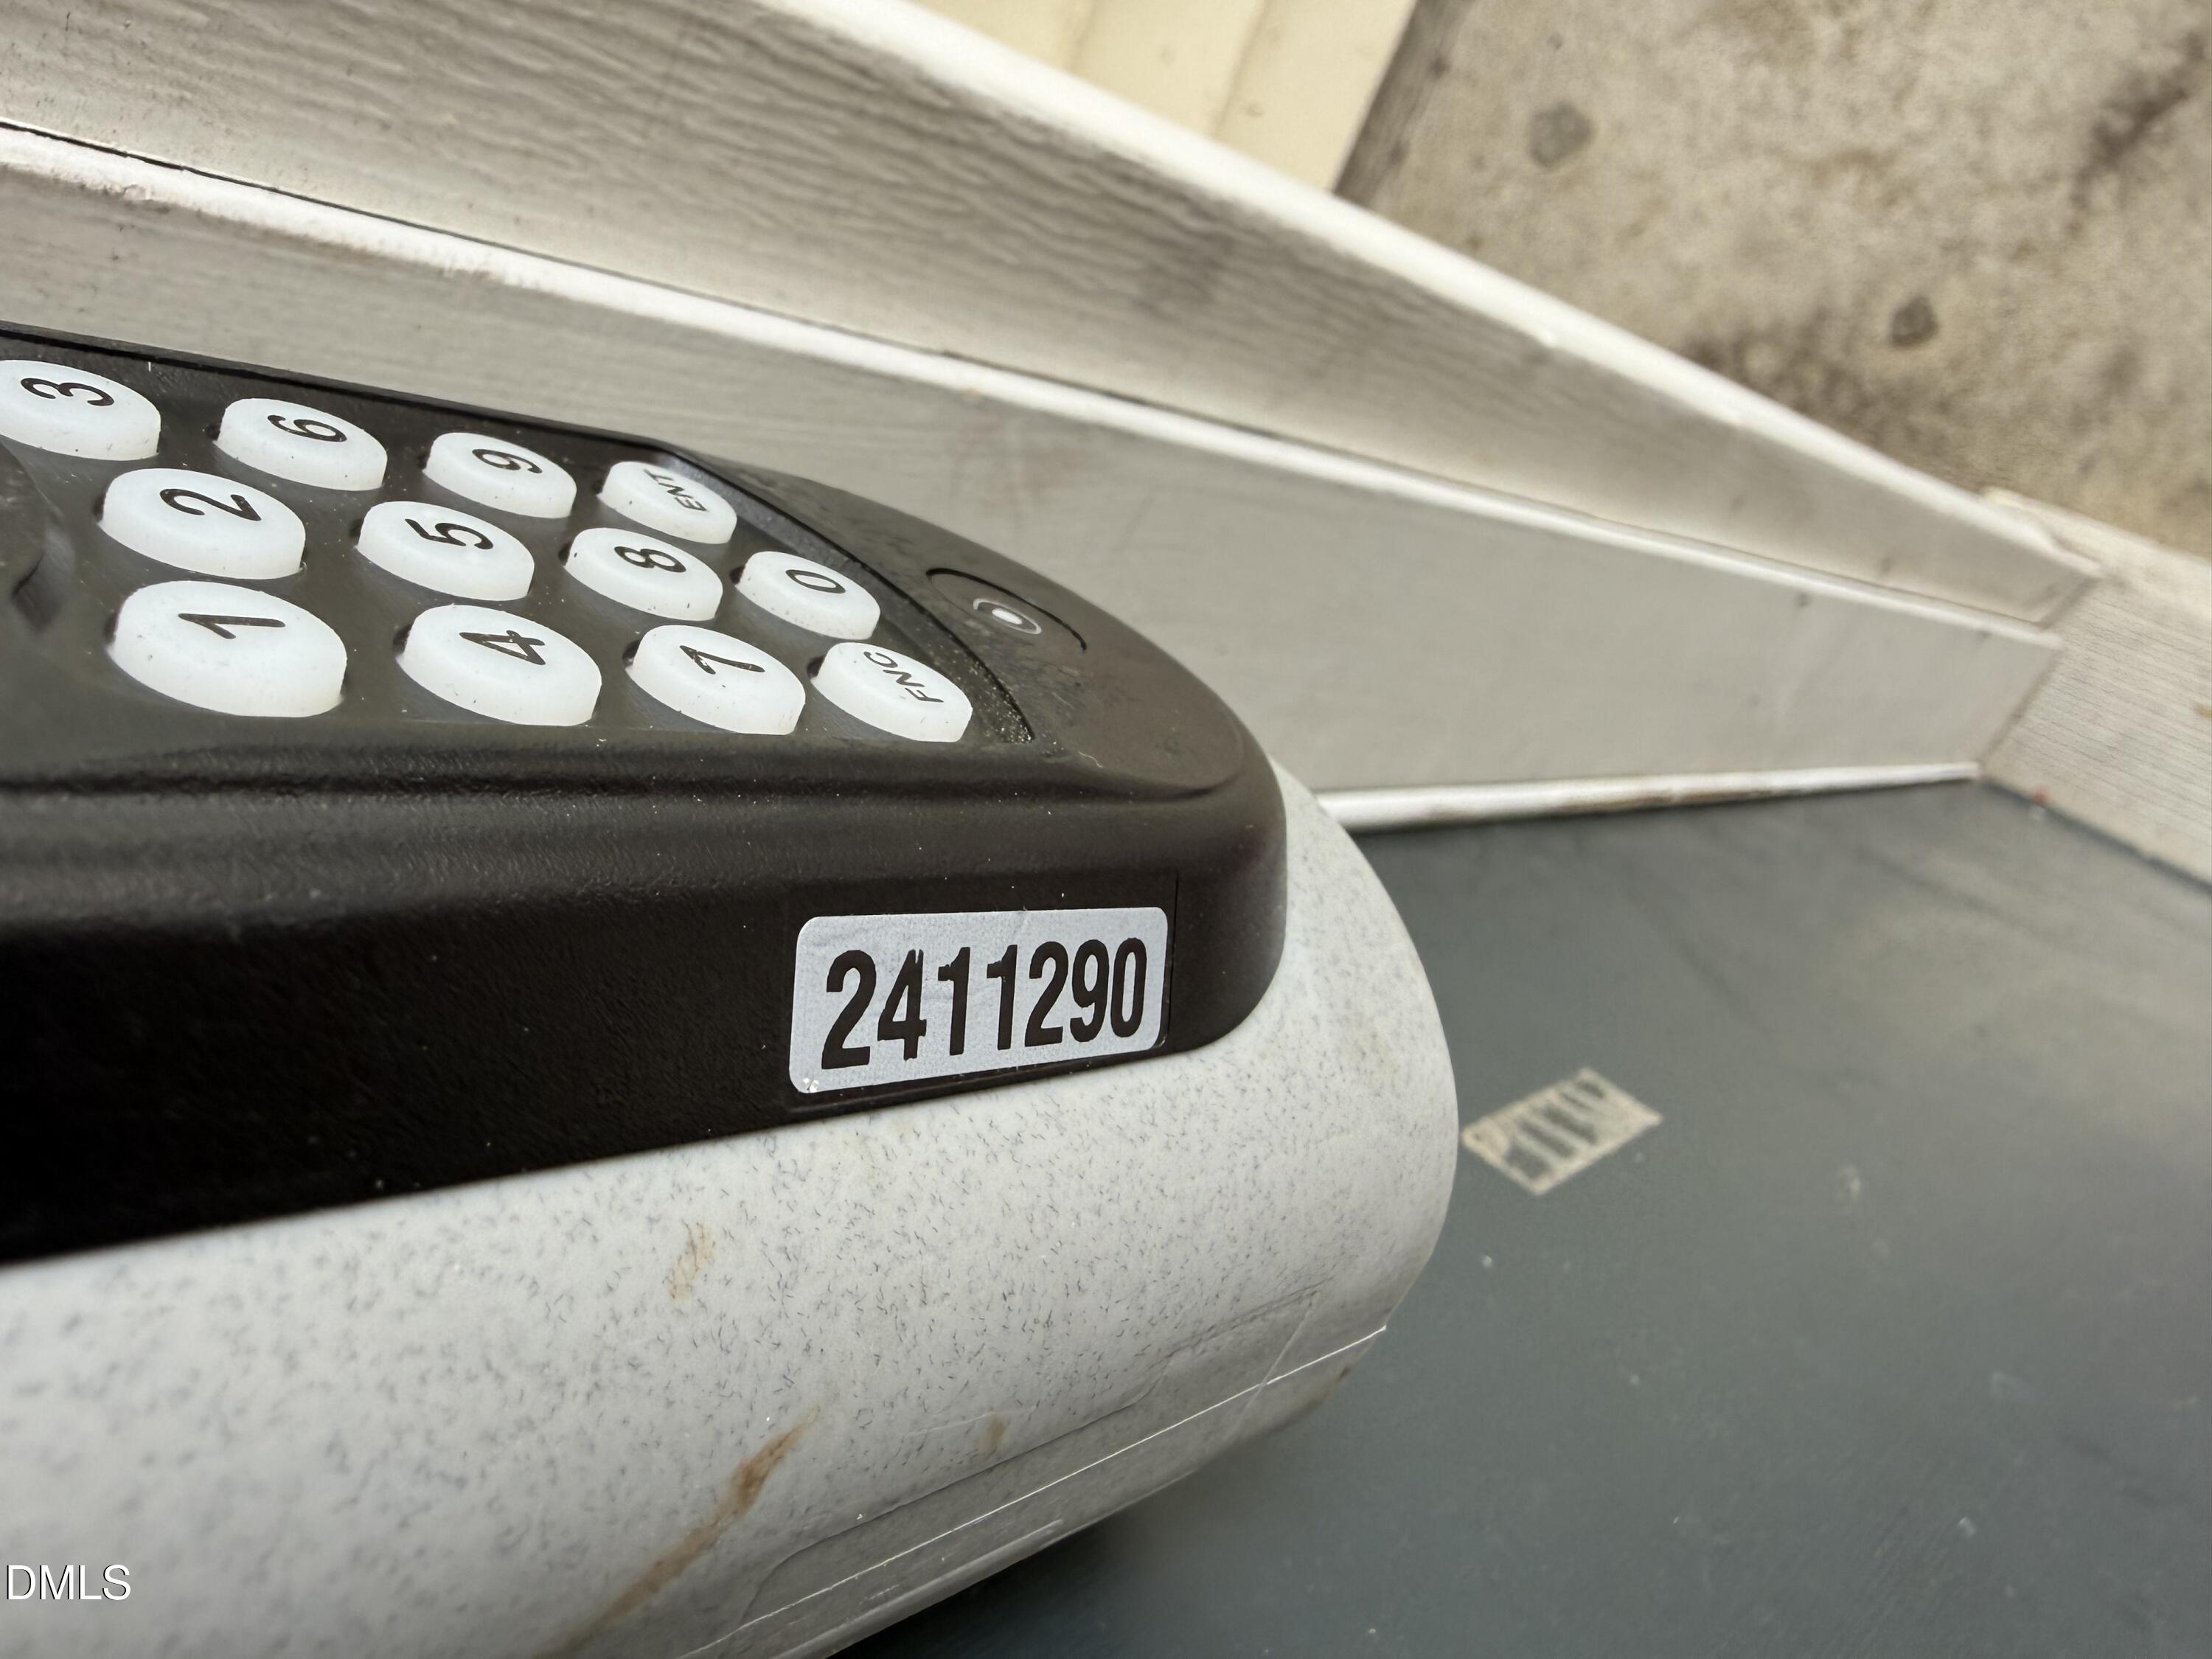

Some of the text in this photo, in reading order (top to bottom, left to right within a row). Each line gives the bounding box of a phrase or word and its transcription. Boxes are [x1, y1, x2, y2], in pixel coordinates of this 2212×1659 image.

[21, 378, 114, 406] 3
[267, 414, 347, 442] 6
[472, 448, 544, 474] 9
[160, 488, 262, 521] 2
[644, 469, 706, 512] ENT
[404, 518, 493, 550] 5
[614, 546, 686, 573] 8
[785, 569, 846, 594] 0
[178, 613, 285, 639] 1
[459, 630, 546, 666] 4
[680, 645, 765, 675] 7
[863, 650, 944, 703] FNC
[821, 937, 1147, 1069] 2411290
